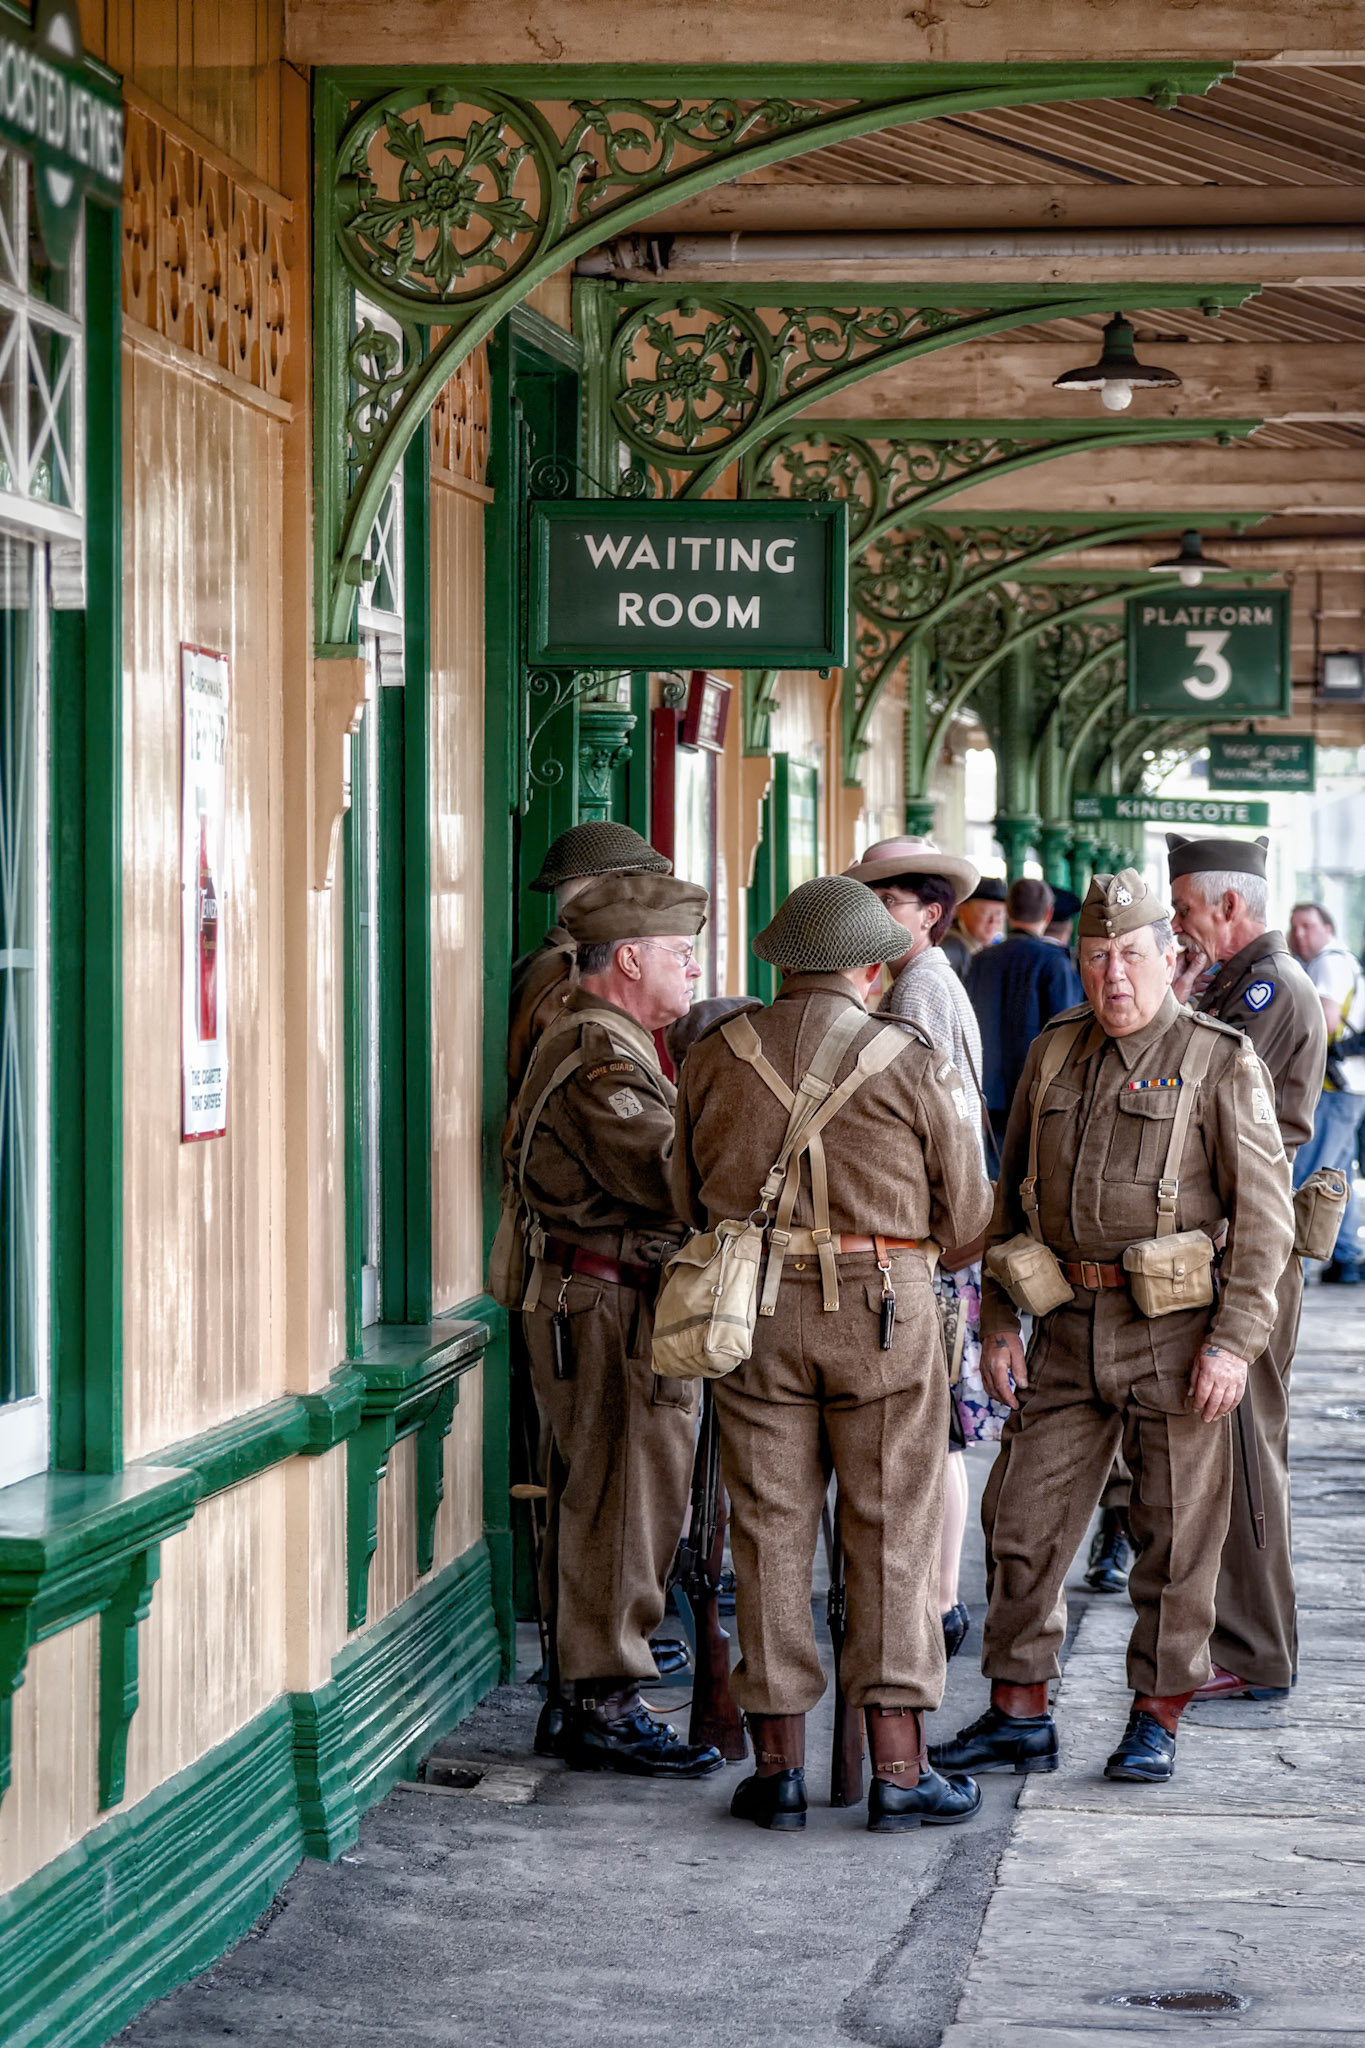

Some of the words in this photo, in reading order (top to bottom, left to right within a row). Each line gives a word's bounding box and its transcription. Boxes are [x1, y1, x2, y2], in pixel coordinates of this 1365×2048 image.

[70, 82, 124, 184] KEYNES
[583, 533, 797, 574] WAITING
[618, 592, 761, 629] ROOM
[1143, 606, 1273, 626] PLATFORM
[1182, 630, 1232, 701] 3
[1222, 744, 1260, 760] WAY
[1265, 744, 1303, 761] OUT
[1116, 800, 1250, 822] KINGSCOTE
[587, 1065, 608, 1081] HOME
[609, 1063, 635, 1072] GUARD
[614, 1089, 633, 1106] SX
[622, 1102, 640, 1117] 23
